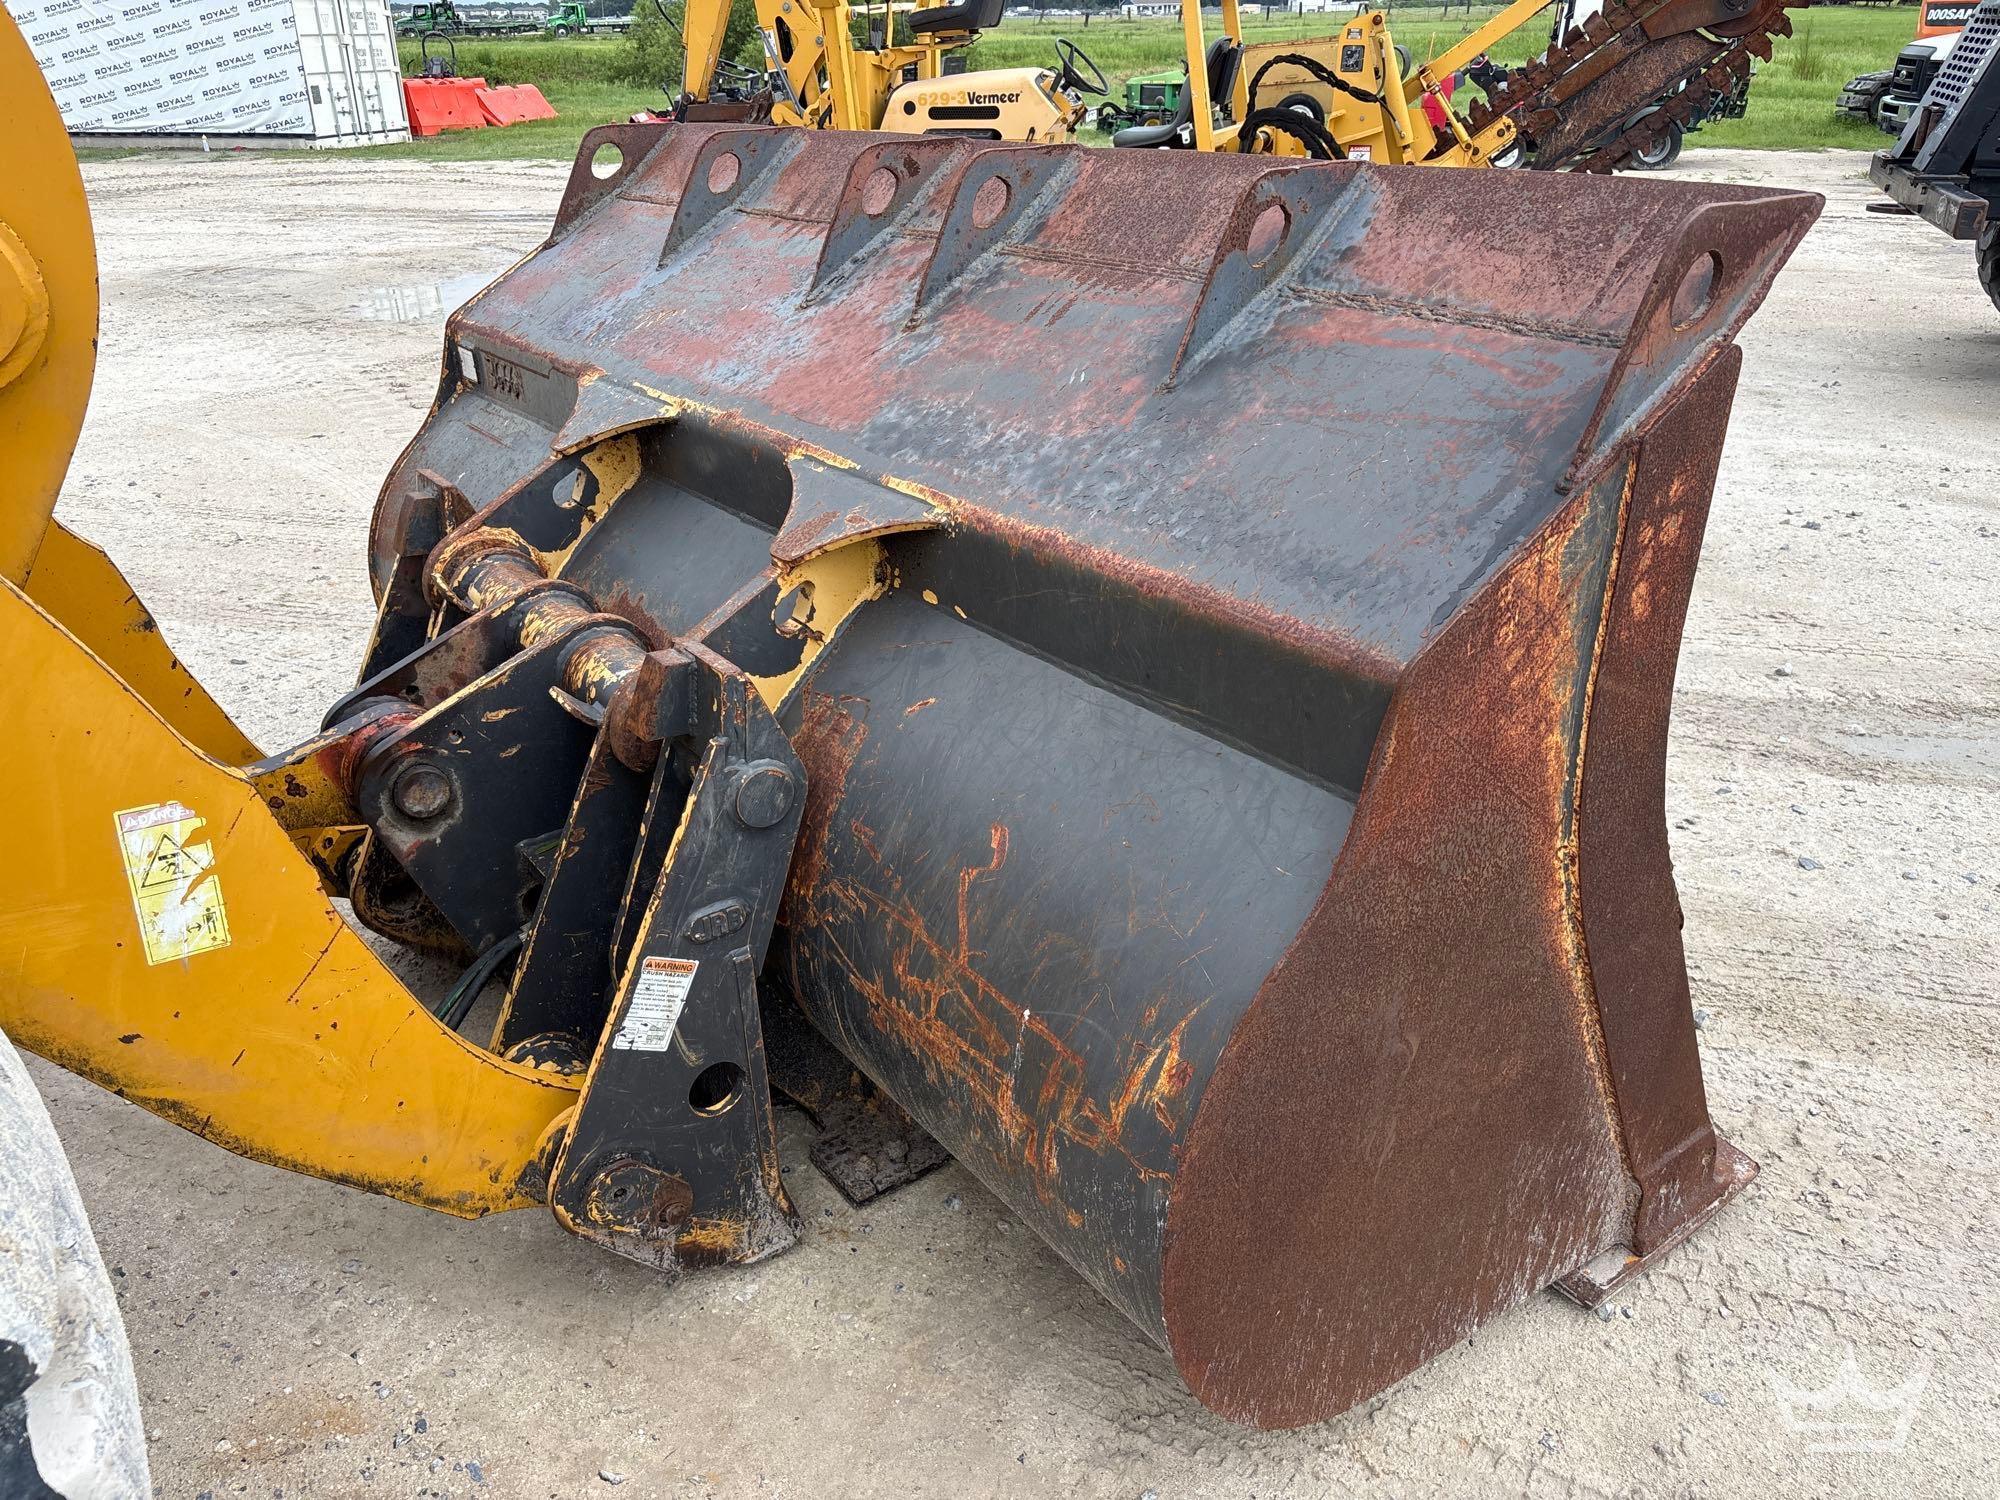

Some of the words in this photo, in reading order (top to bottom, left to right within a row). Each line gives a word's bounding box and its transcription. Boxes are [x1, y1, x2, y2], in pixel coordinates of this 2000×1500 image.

[44, 1, 73, 13] ROYAL
[123, 4, 152, 16] ROYAL
[200, 9, 230, 21] ROYAL
[77, 18, 106, 30] ROYAL
[153, 22, 183, 34] ROYAL
[32, 30, 61, 42] ROYAL
[233, 26, 263, 38] ROYAL
[107, 35, 136, 47] ROYAL
[186, 39, 216, 51] ROYAL
[62, 47, 91, 59] ROYAL
[264, 43, 296, 55] ROYAL
[140, 51, 169, 63] ROYAL
[216, 56, 246, 68] ROYAL
[95, 63, 124, 75] ROYAL
[169, 68, 199, 80] ROYAL
[50, 75, 79, 87] ROYAL
[249, 73, 279, 85] ROYAL
[124, 80, 153, 92] ROYAL
[202, 85, 233, 97] ROYAL
[80, 92, 109, 104] ROYAL
[157, 97, 187, 109] ROYAL
[917, 91, 967, 106] 629-3
[967, 91, 1020, 105] Vermeer
[112, 108, 141, 120] ROYAL
[232, 102, 262, 114] ROYAL
[186, 113, 215, 125] ROYAL
[266, 118, 295, 130] ROYAL
[67, 120, 95, 131] ROYAL
[136, 805, 190, 825] DANGE
[654, 961, 693, 971] WARNING
